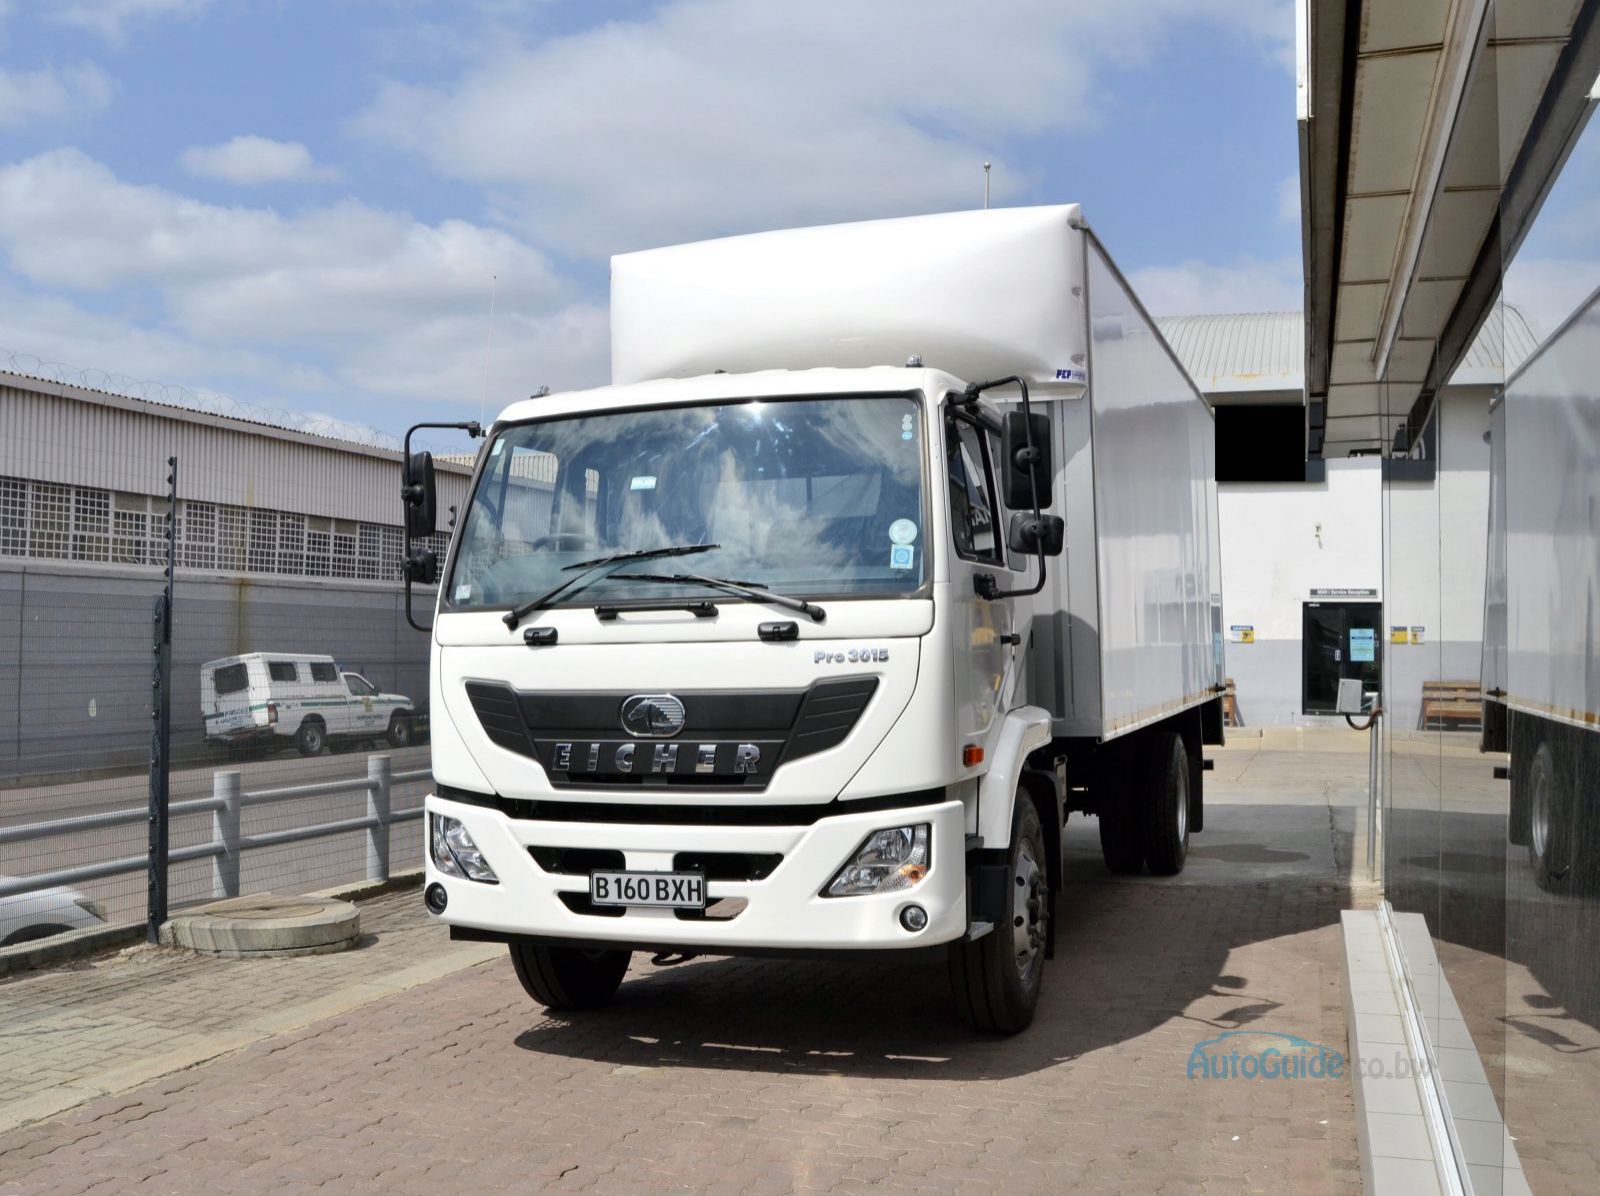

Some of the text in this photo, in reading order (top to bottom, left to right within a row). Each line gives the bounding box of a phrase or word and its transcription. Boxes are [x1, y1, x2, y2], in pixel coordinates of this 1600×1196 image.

[814, 648, 889, 664] Pro 3015
[552, 743, 761, 774] EICHER
[595, 877, 702, 902] B 160 BXH
